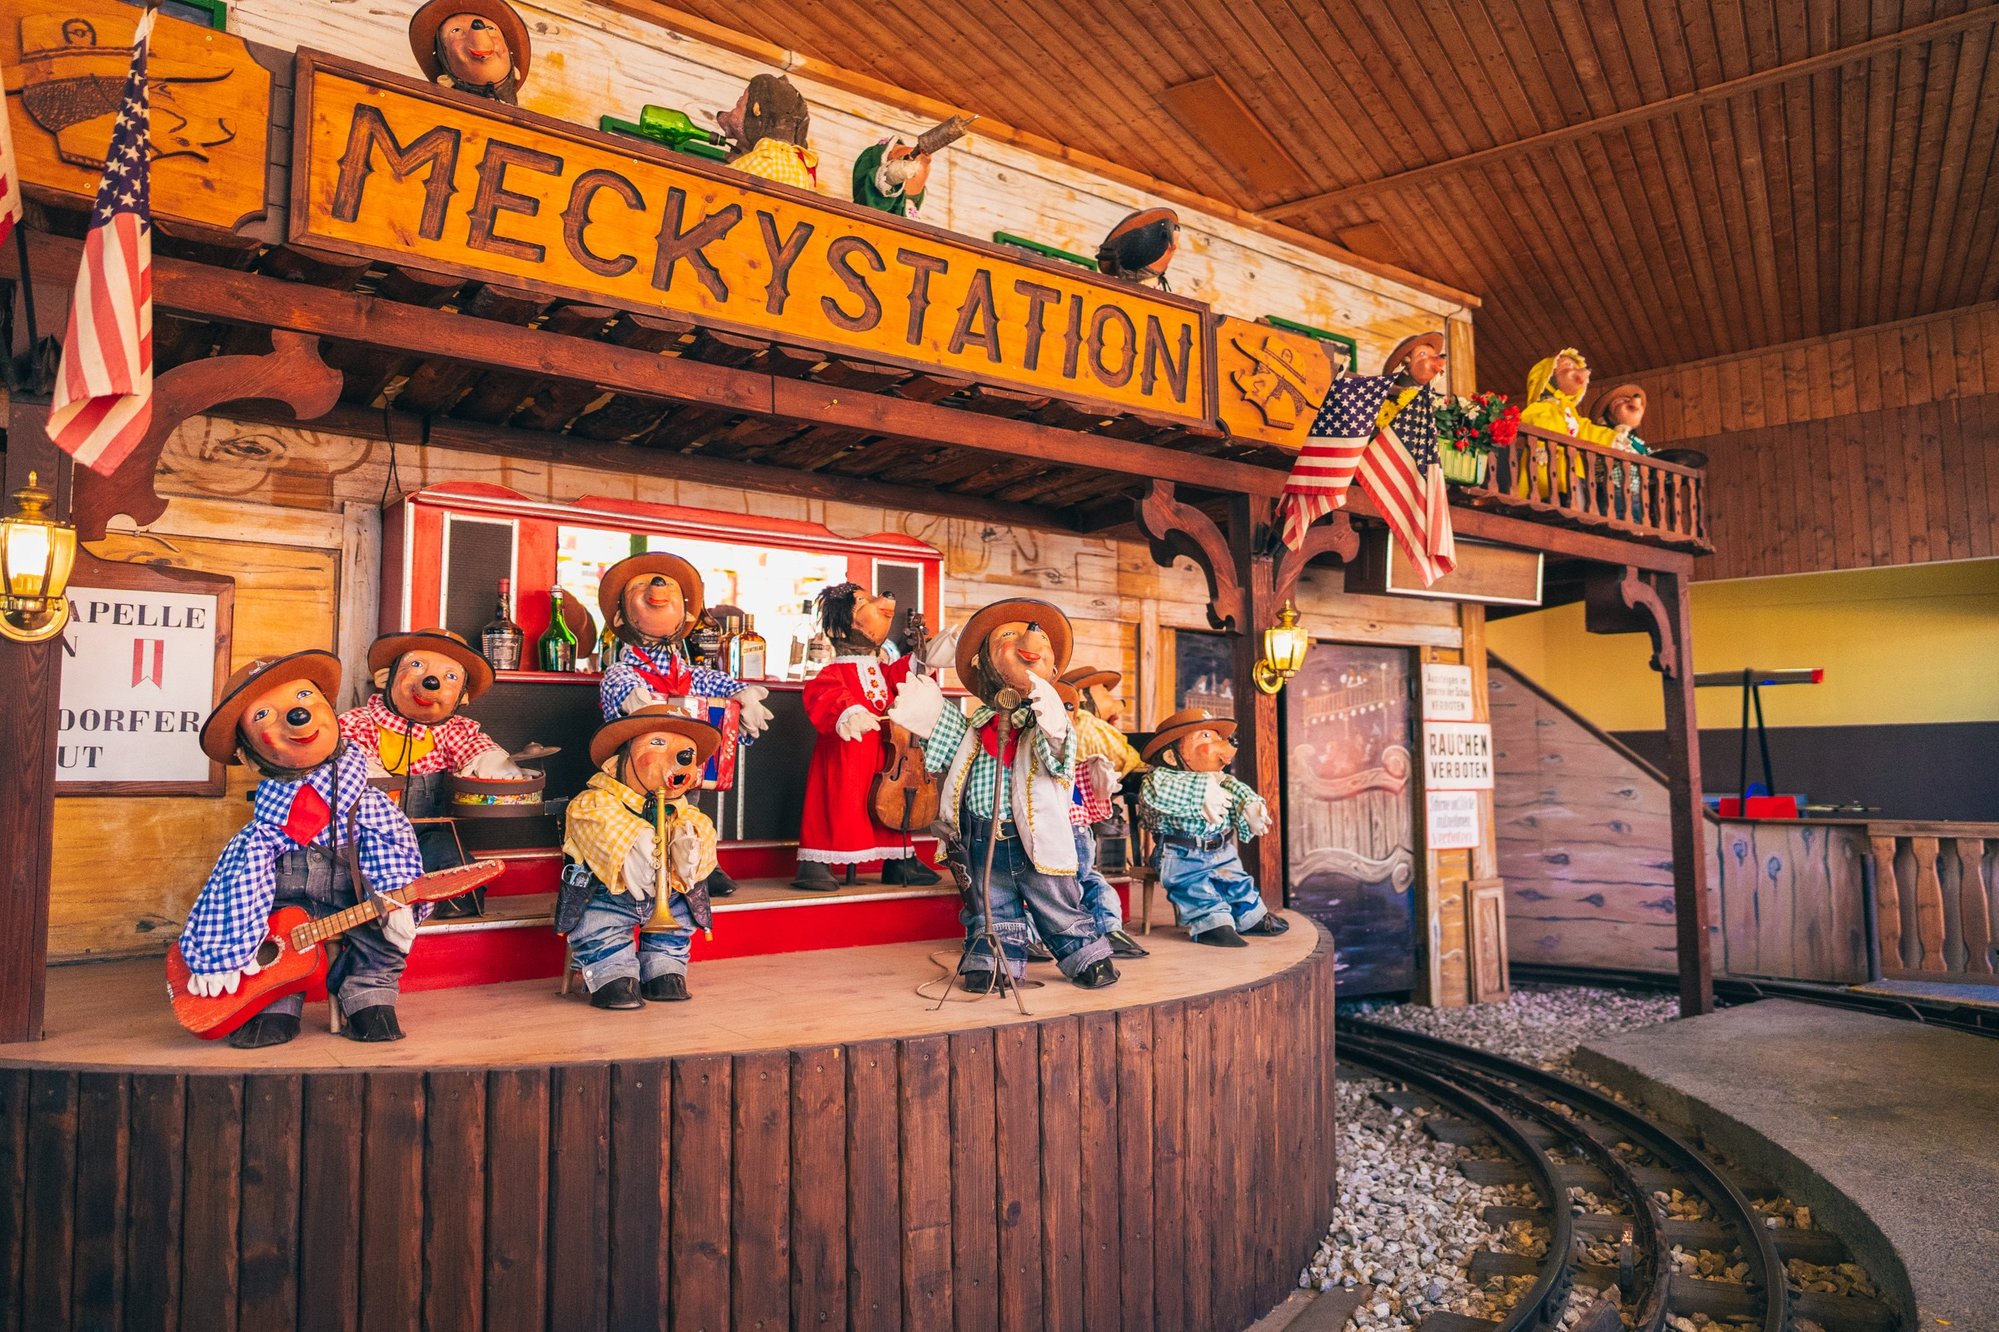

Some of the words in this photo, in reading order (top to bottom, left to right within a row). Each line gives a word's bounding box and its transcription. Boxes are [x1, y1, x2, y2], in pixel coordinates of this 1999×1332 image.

[332, 102, 1193, 404] MECKYSTATION
[1429, 733, 1488, 756] RAUCHEN
[57, 745, 103, 769] UT
[1431, 761, 1488, 779] VERBOTEN
